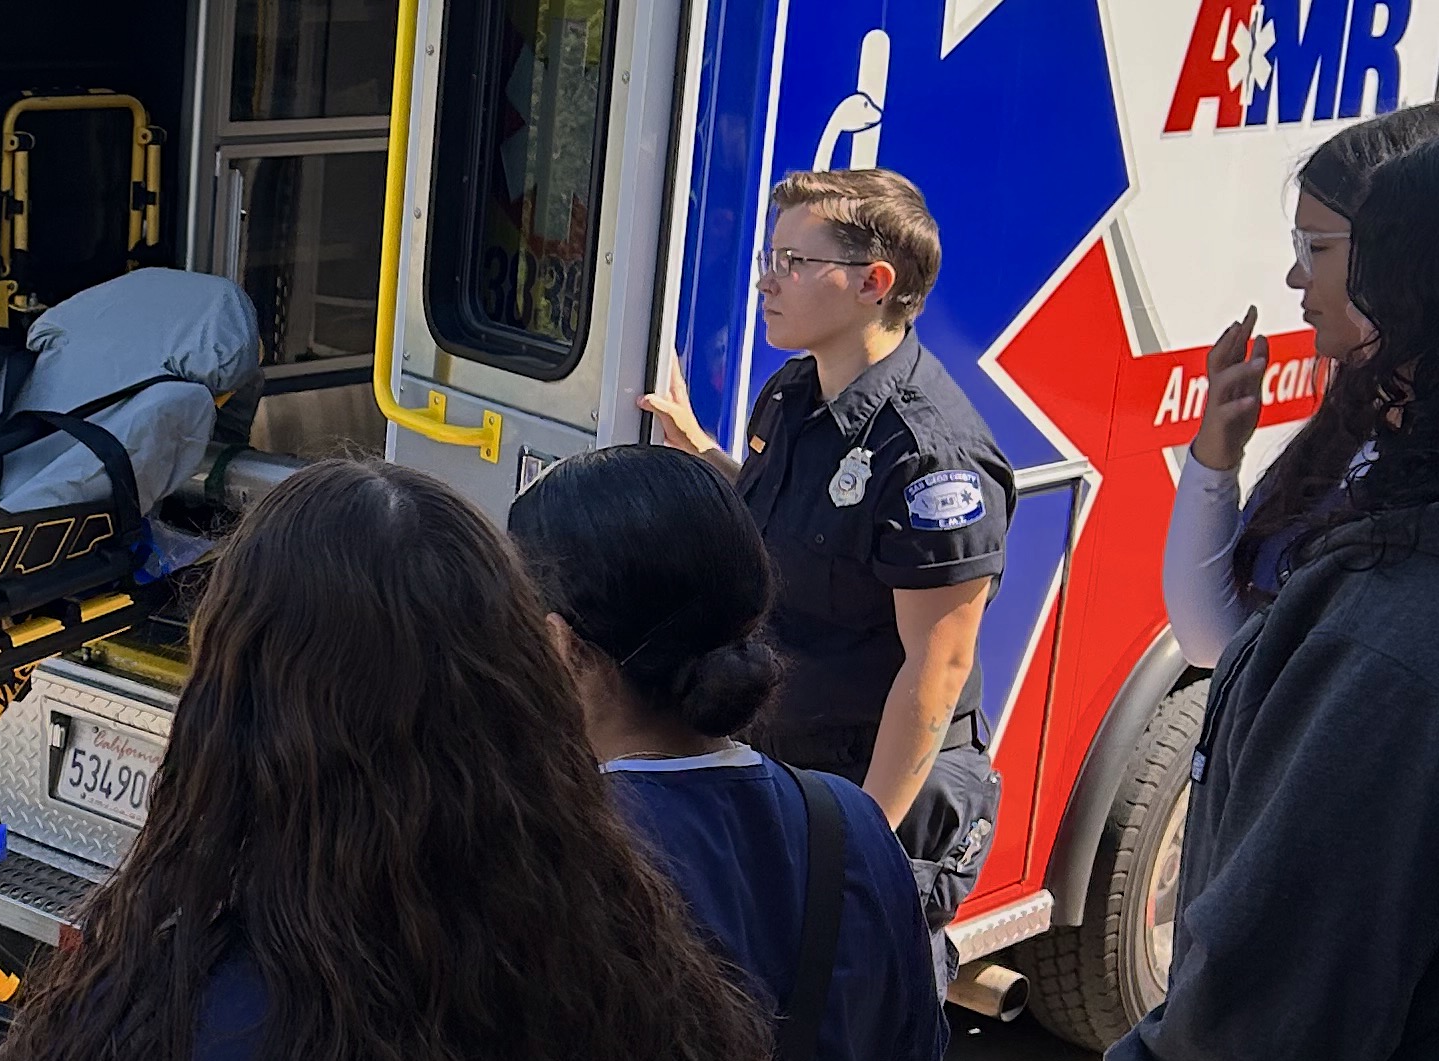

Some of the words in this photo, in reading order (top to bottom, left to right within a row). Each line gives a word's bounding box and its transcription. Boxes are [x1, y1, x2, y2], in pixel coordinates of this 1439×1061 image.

[1163, 0, 1411, 133] AMR
[1153, 356, 1318, 427] Amcan
[69, 747, 150, 812] 53490
